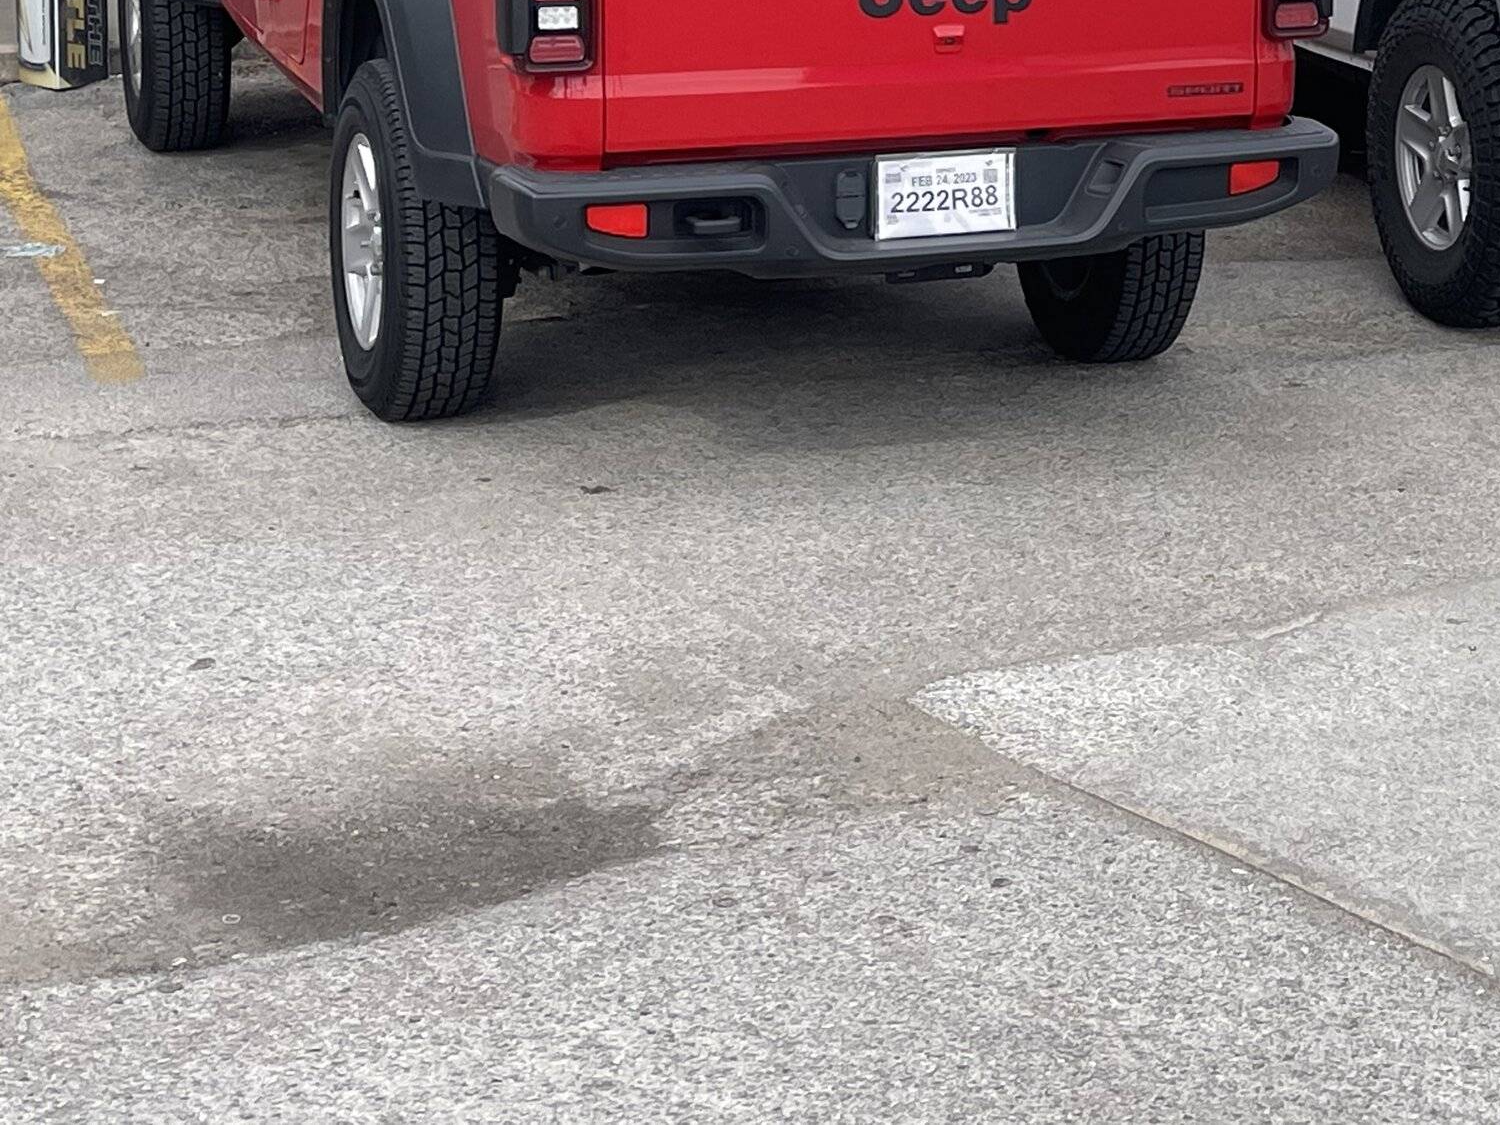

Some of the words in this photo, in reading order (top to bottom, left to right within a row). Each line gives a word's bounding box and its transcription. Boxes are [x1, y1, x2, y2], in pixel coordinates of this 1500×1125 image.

[911, 175, 933, 187] FEB
[953, 172, 977, 184] 2023
[890, 184, 999, 213] 2222R88
